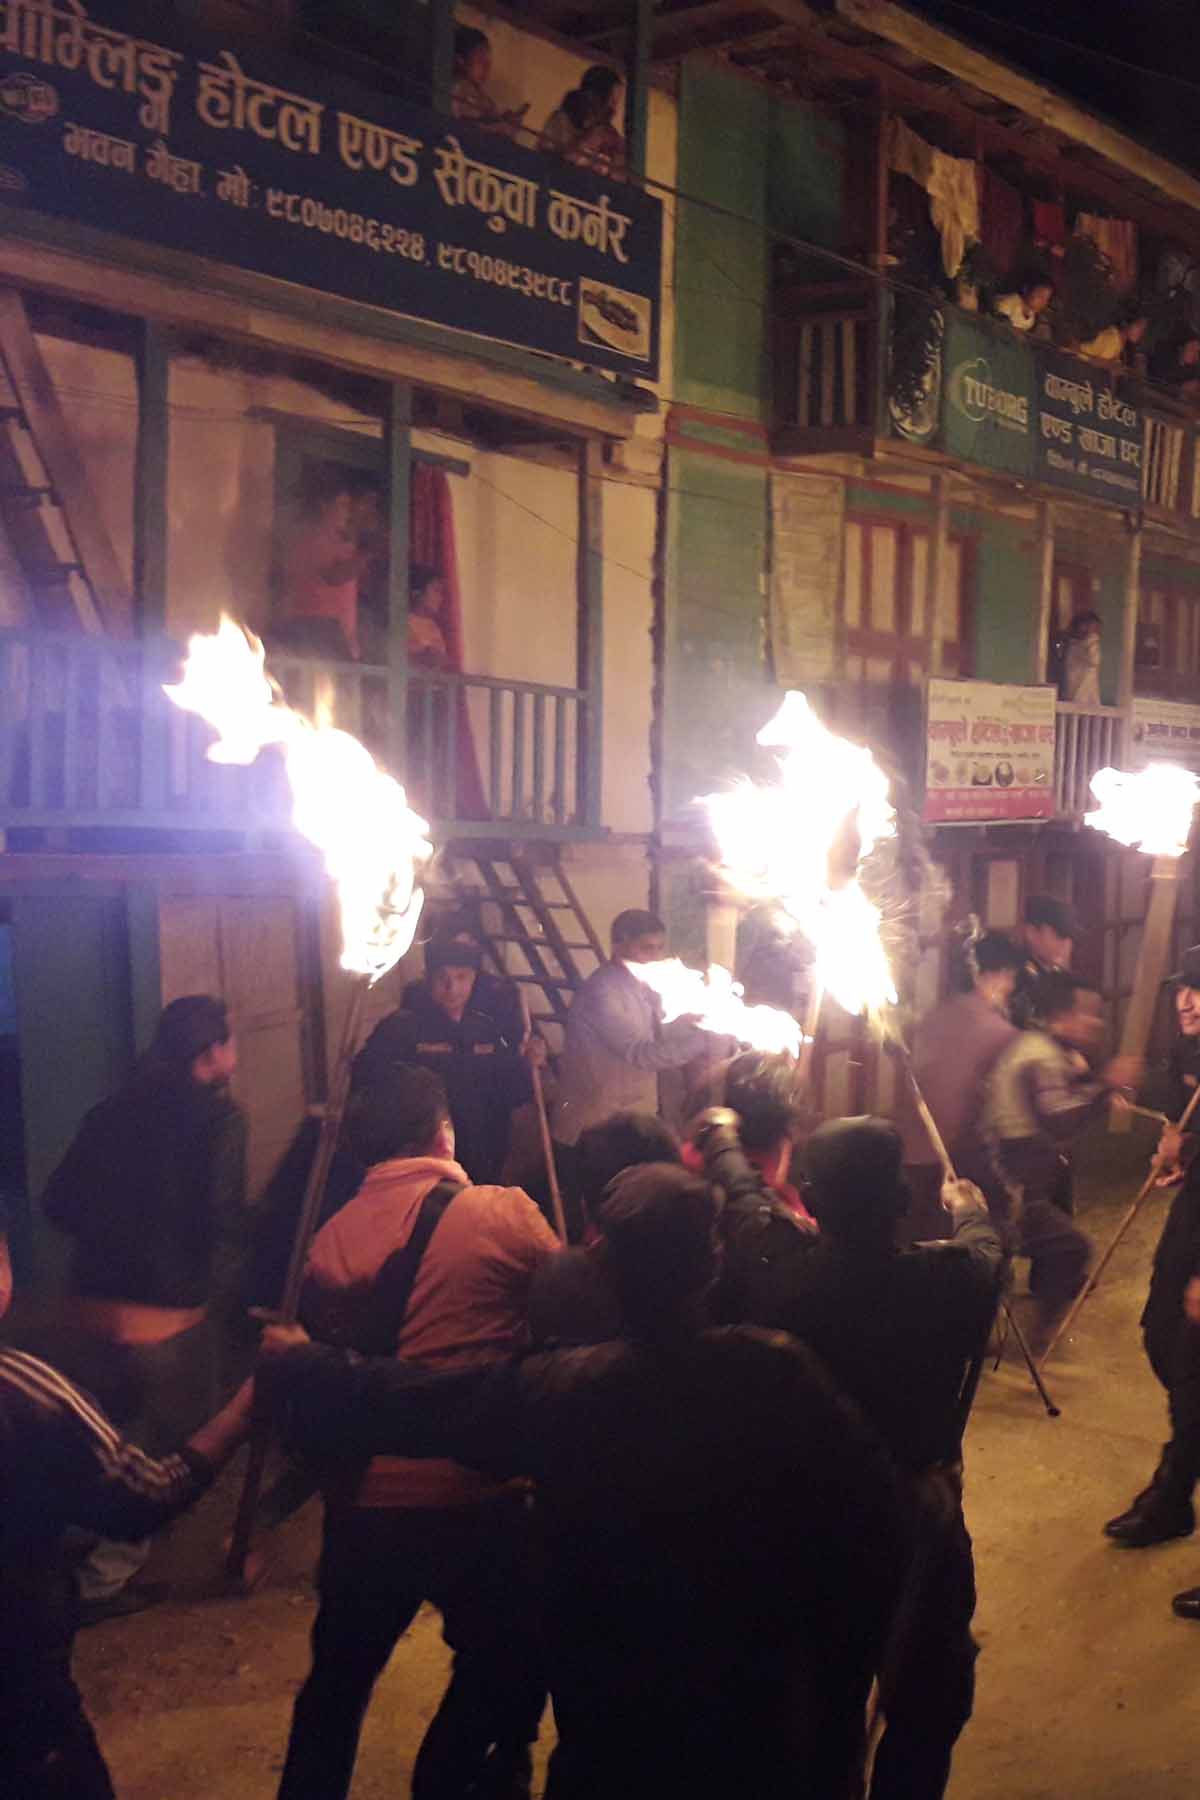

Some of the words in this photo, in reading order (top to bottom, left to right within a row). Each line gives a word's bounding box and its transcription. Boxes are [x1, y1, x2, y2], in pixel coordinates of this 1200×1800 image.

[197, 50, 325, 154] होटल
[337, 111, 424, 187] एण्ड
[433, 134, 540, 234] सेकुवा
[547, 194, 633, 264] कर्नर
[964, 375, 1029, 424] TUBORG
